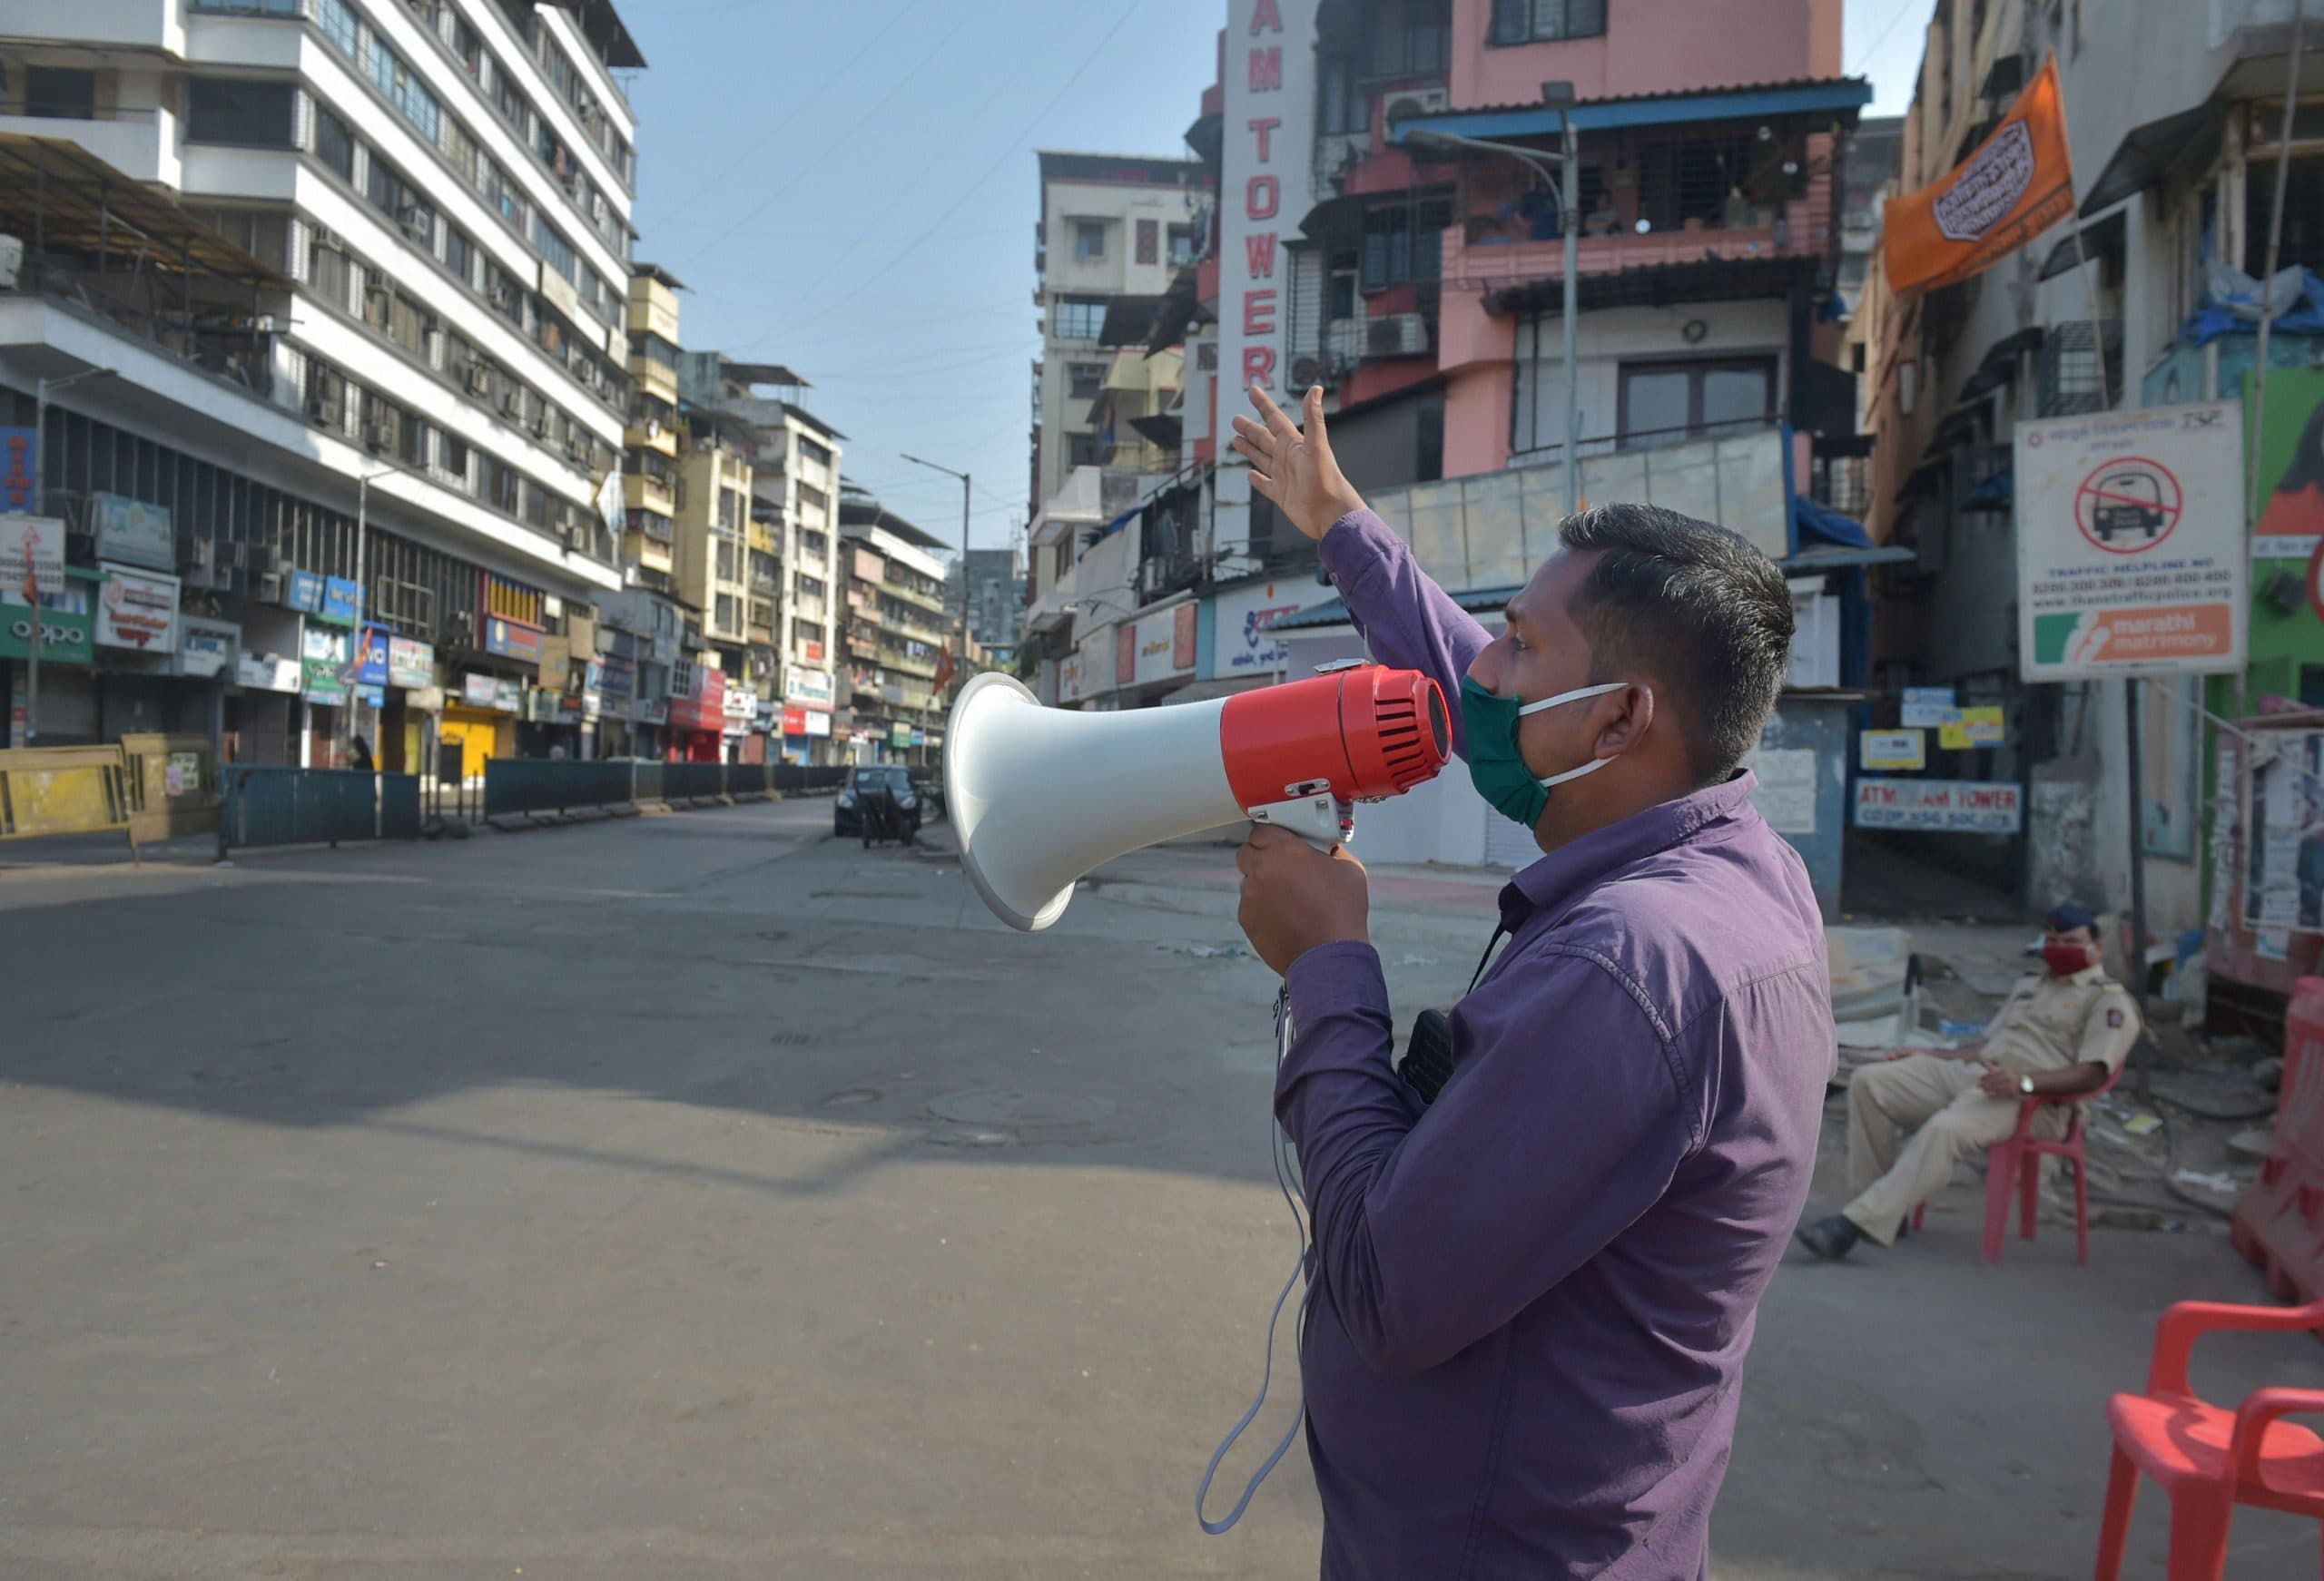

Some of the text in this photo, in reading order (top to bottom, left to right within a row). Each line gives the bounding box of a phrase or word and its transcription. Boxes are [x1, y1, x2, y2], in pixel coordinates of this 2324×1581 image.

[1242, 115, 1281, 391] TOWER
[2048, 563, 2107, 577] TRAFFIC
[2113, 558, 2185, 574] HELPLINE
[2114, 612, 2196, 633] marathi
[2114, 633, 2217, 652] matrimony
